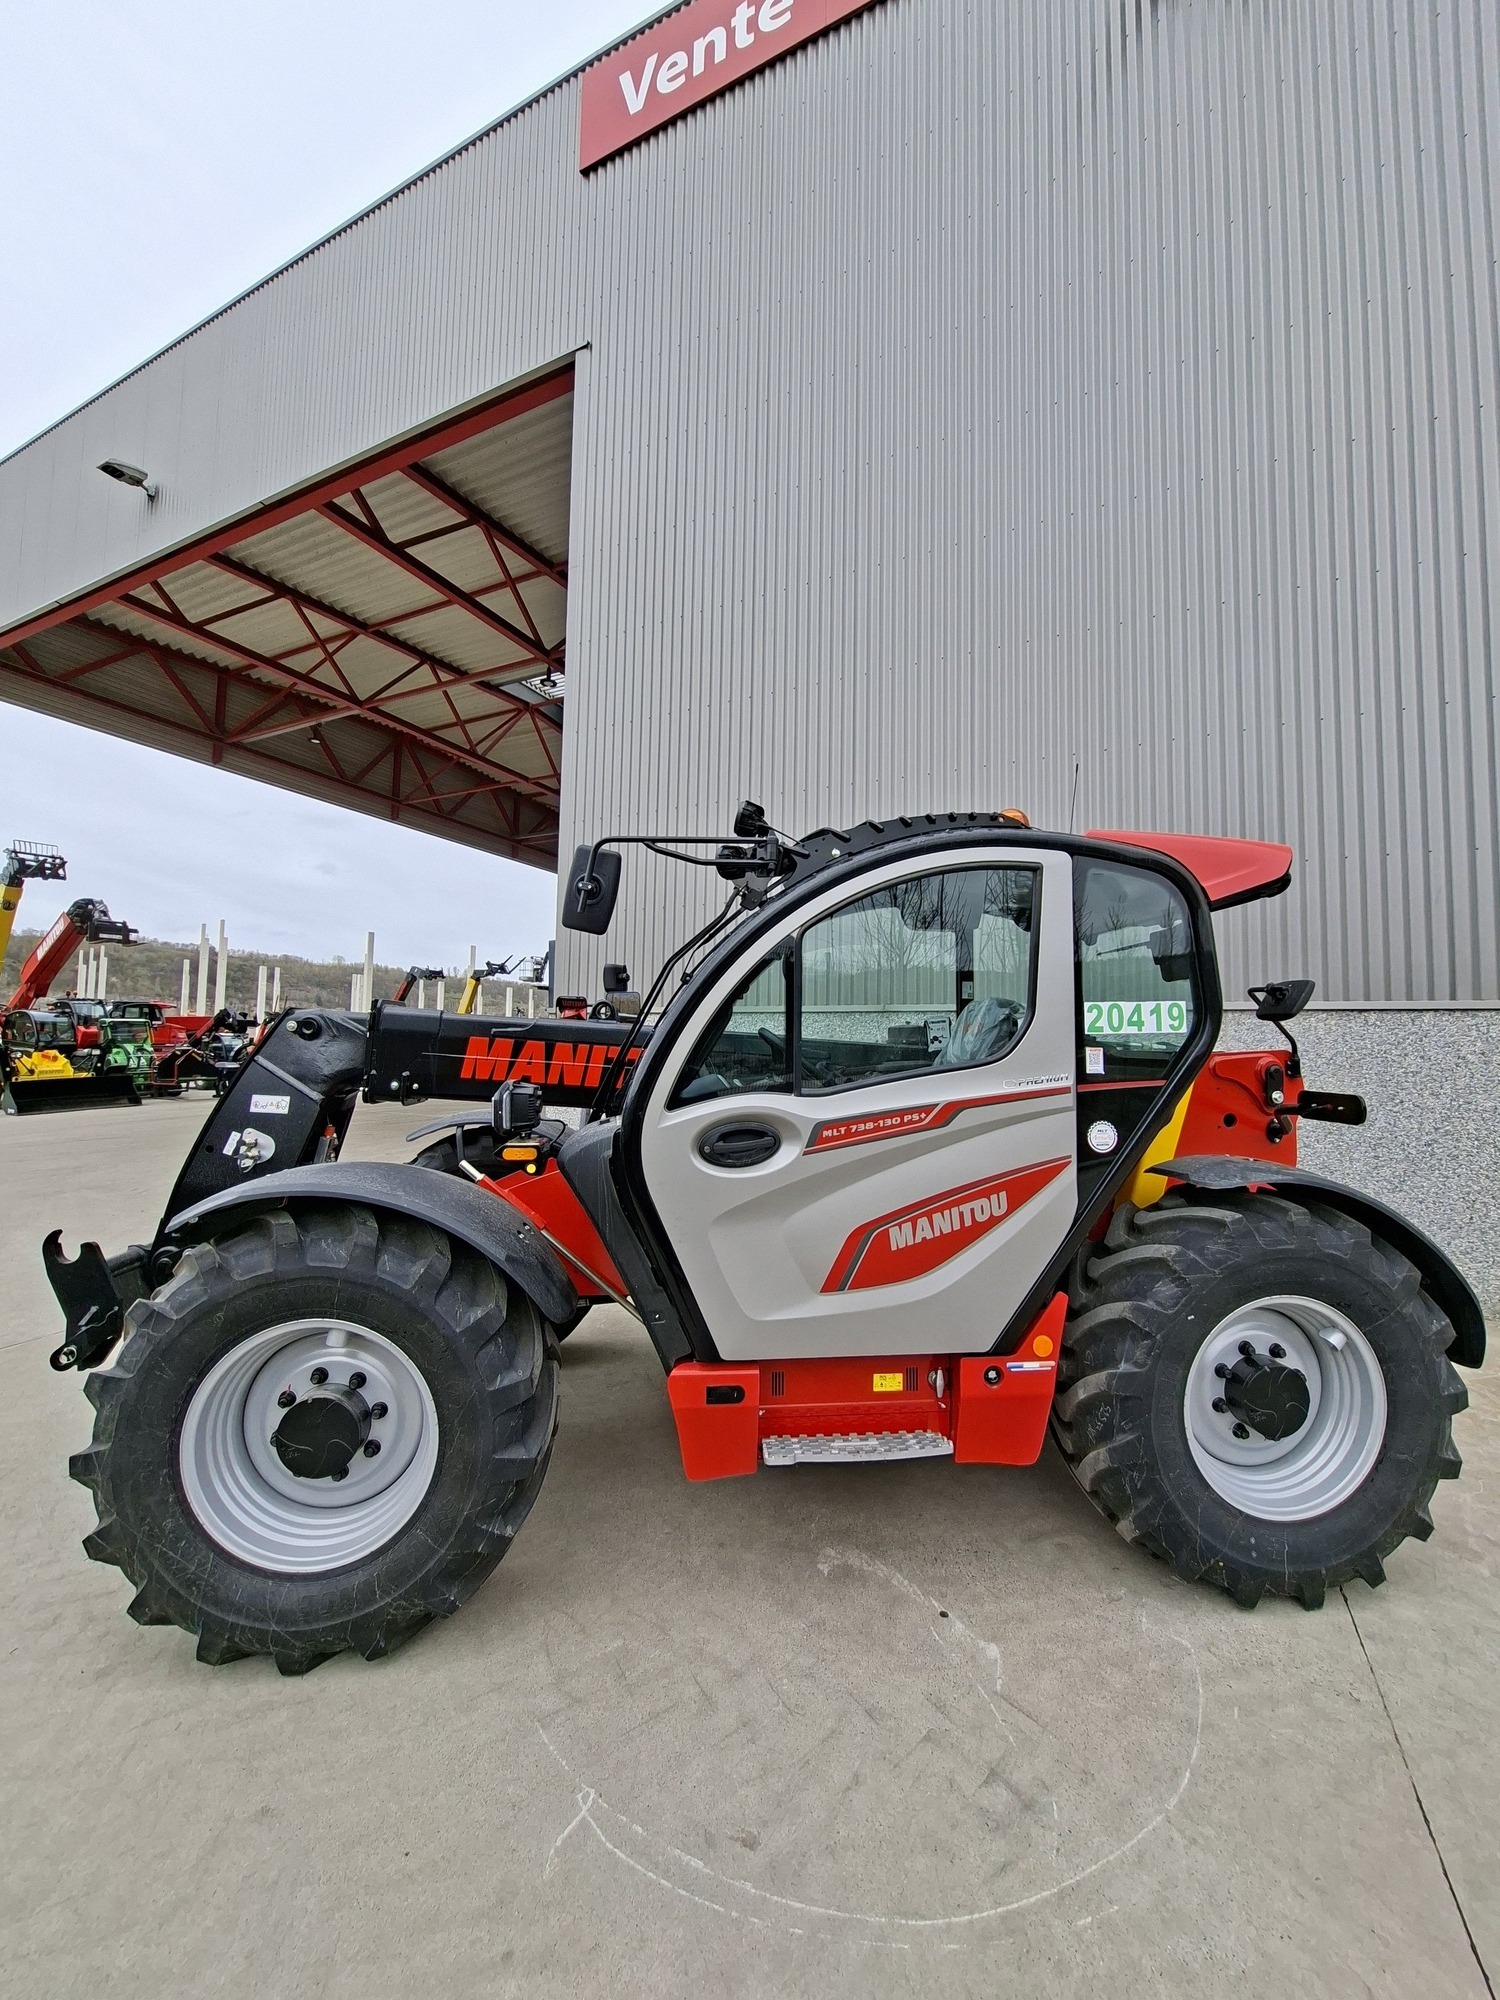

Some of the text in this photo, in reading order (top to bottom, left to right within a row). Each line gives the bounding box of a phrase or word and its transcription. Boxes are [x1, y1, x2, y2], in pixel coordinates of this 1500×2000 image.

[617, 0, 795, 116] Vente
[1086, 1002, 1185, 1032] 20419
[1018, 1073, 1069, 1087] PREMIUM
[822, 1112, 927, 1138] MLT 738-130 PS+
[888, 1190, 1008, 1252] MANITOU
